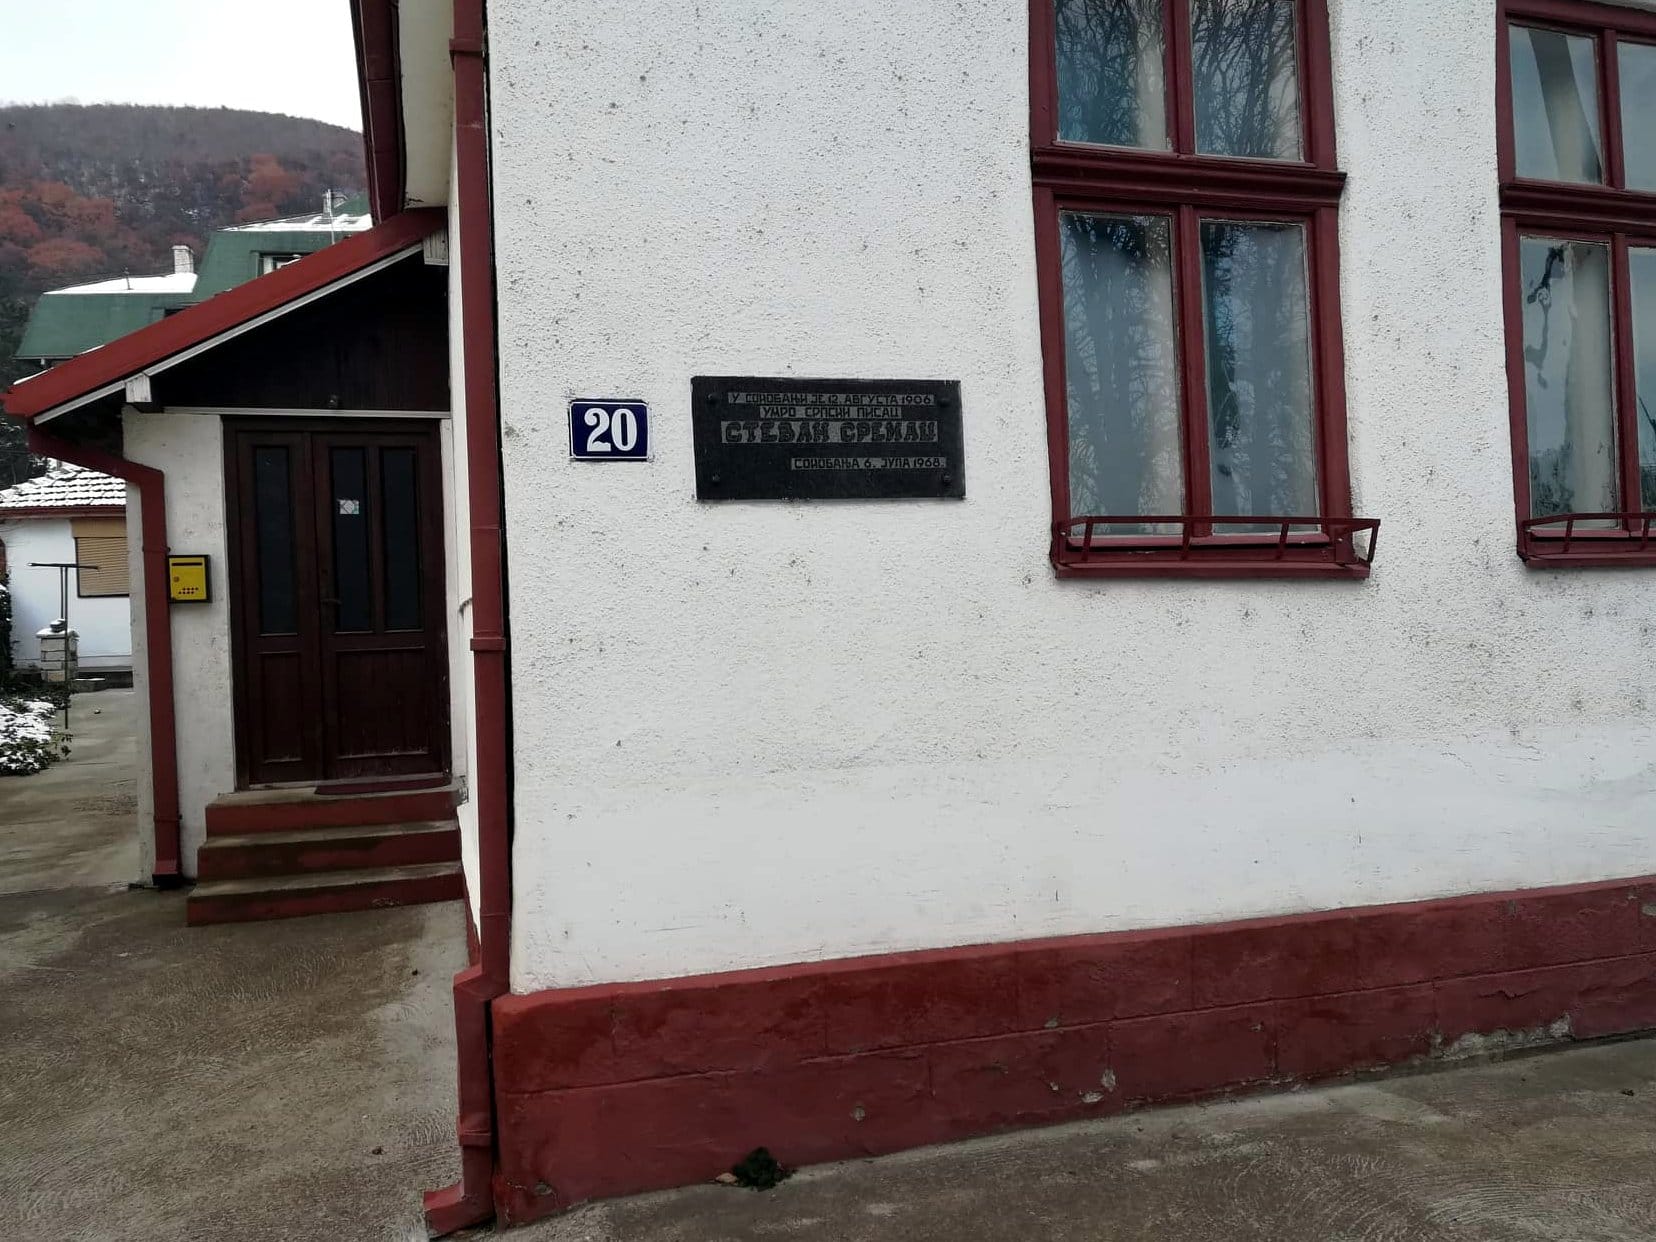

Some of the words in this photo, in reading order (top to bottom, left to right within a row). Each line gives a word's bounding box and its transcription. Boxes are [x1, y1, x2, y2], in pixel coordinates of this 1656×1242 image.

[732, 393, 740, 403] У
[844, 394, 899, 404] АВГУСТА
[764, 406, 796, 418] УМРО
[805, 406, 850, 418] СРПСКИ
[856, 406, 900, 418] ПИСАЦ
[584, 408, 638, 452] 20
[725, 421, 831, 443] СТЕВАН
[839, 421, 937, 443] СРЕМАЦ
